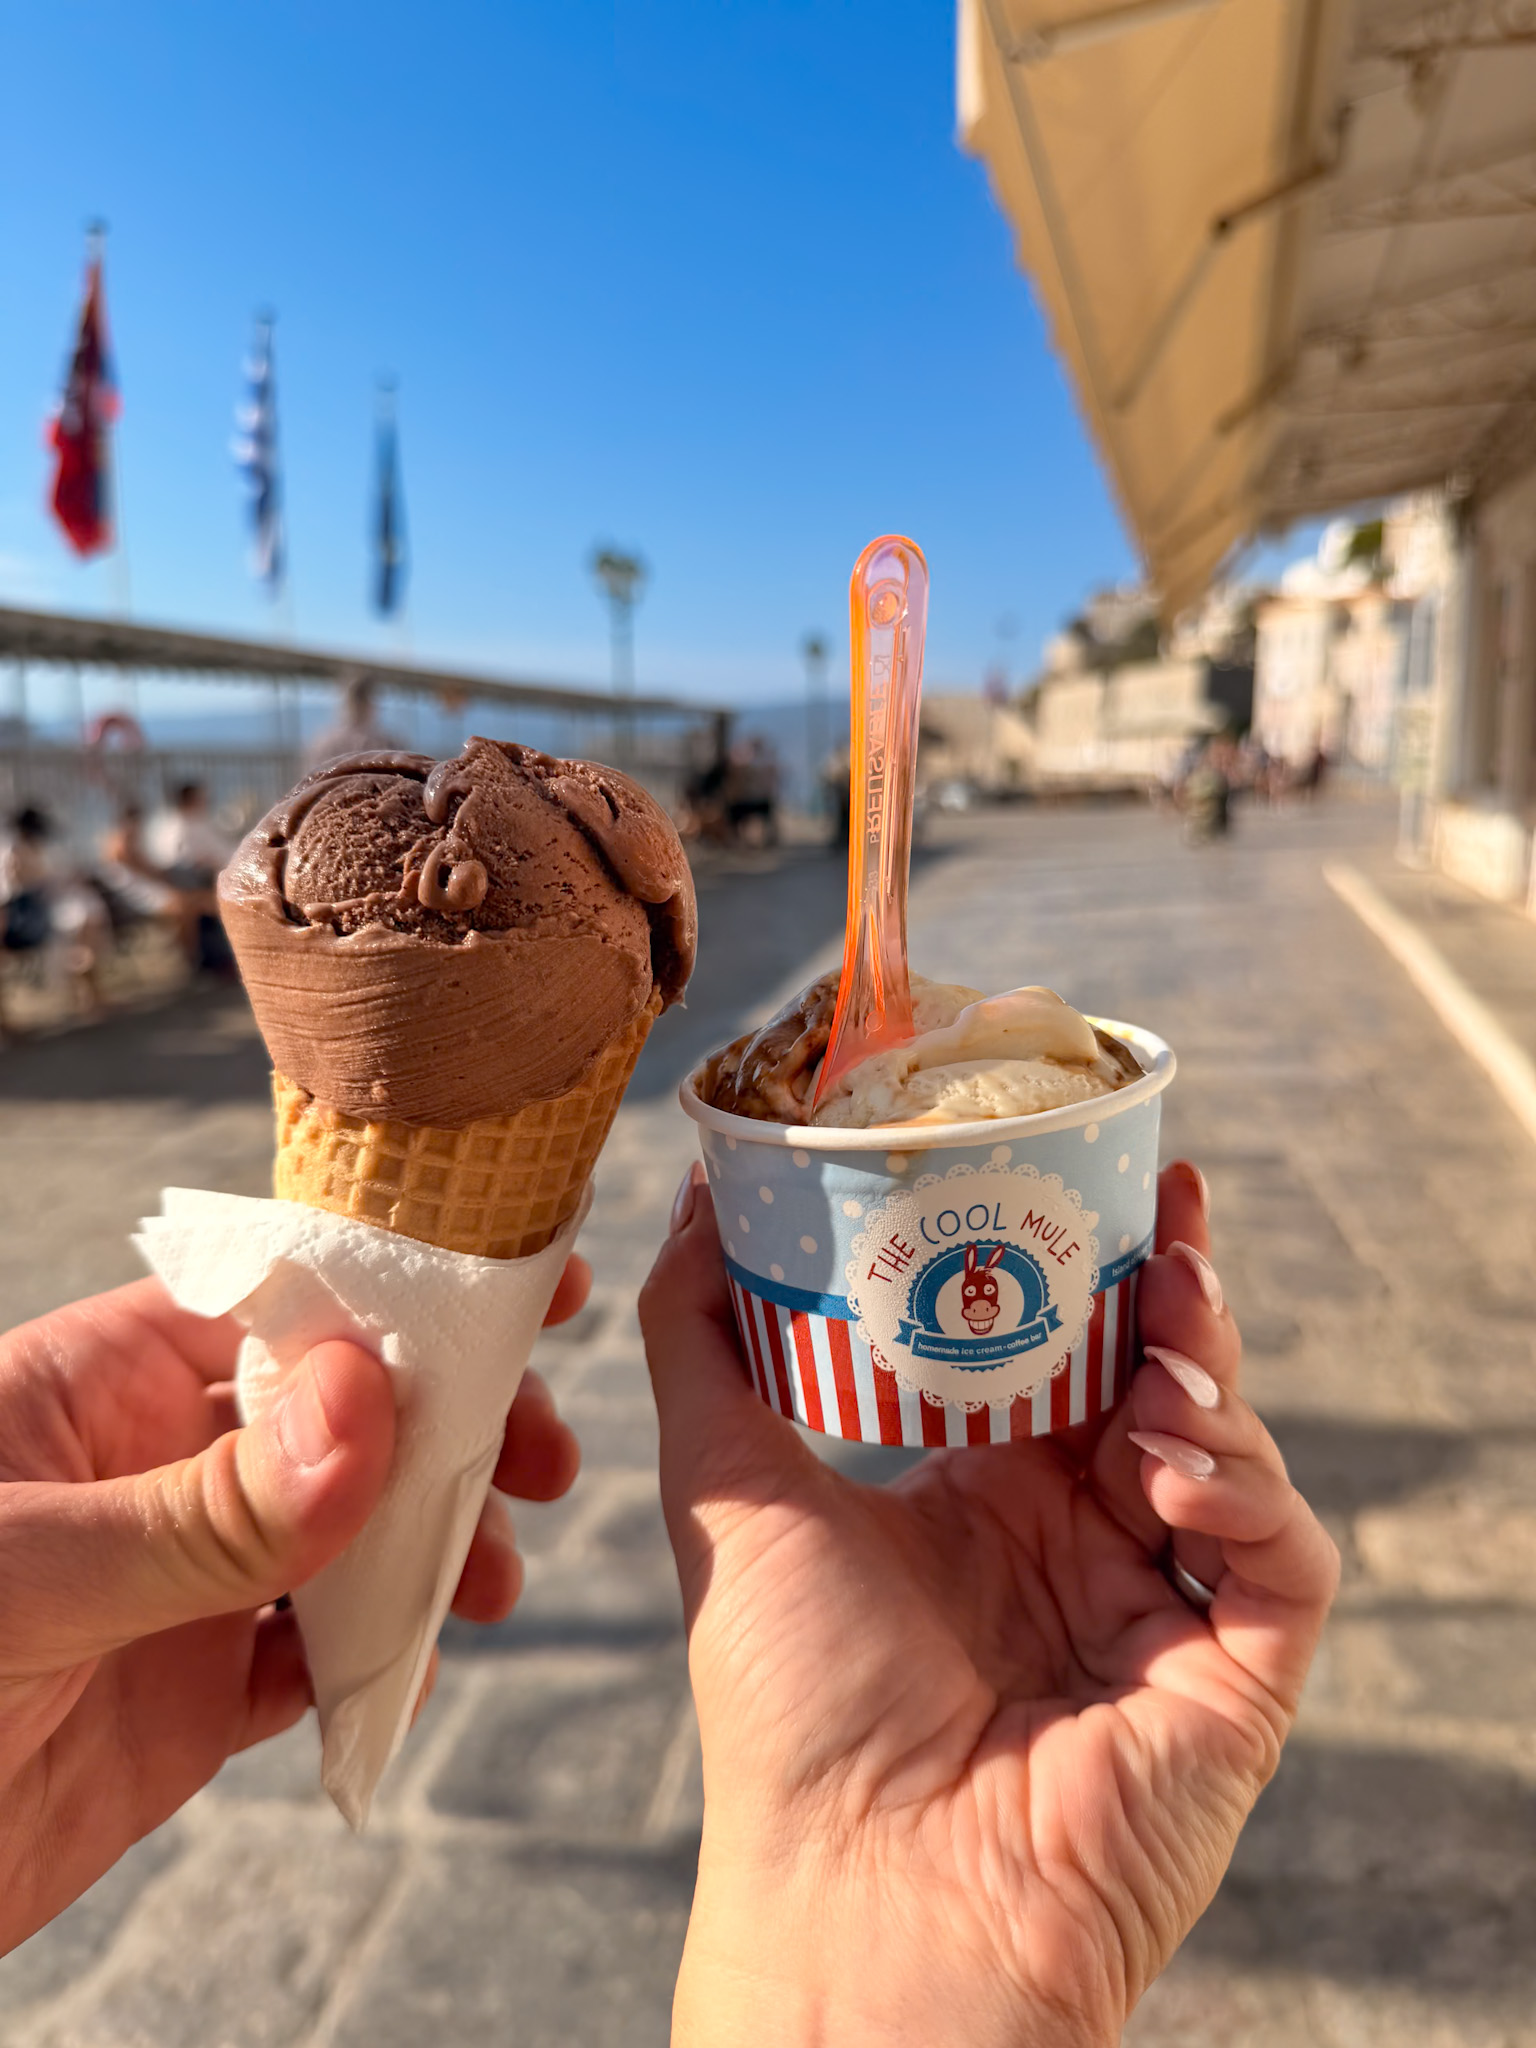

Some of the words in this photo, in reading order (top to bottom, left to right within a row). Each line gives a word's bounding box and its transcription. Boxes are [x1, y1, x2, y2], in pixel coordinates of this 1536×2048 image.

[867, 1233, 916, 1283] THE
[920, 1202, 1007, 1245] COOL
[1020, 1209, 1080, 1266] MULE
[918, 1342, 959, 1355] homemade
[961, 1347, 974, 1355] ice
[1030, 1332, 1042, 1342] bar
